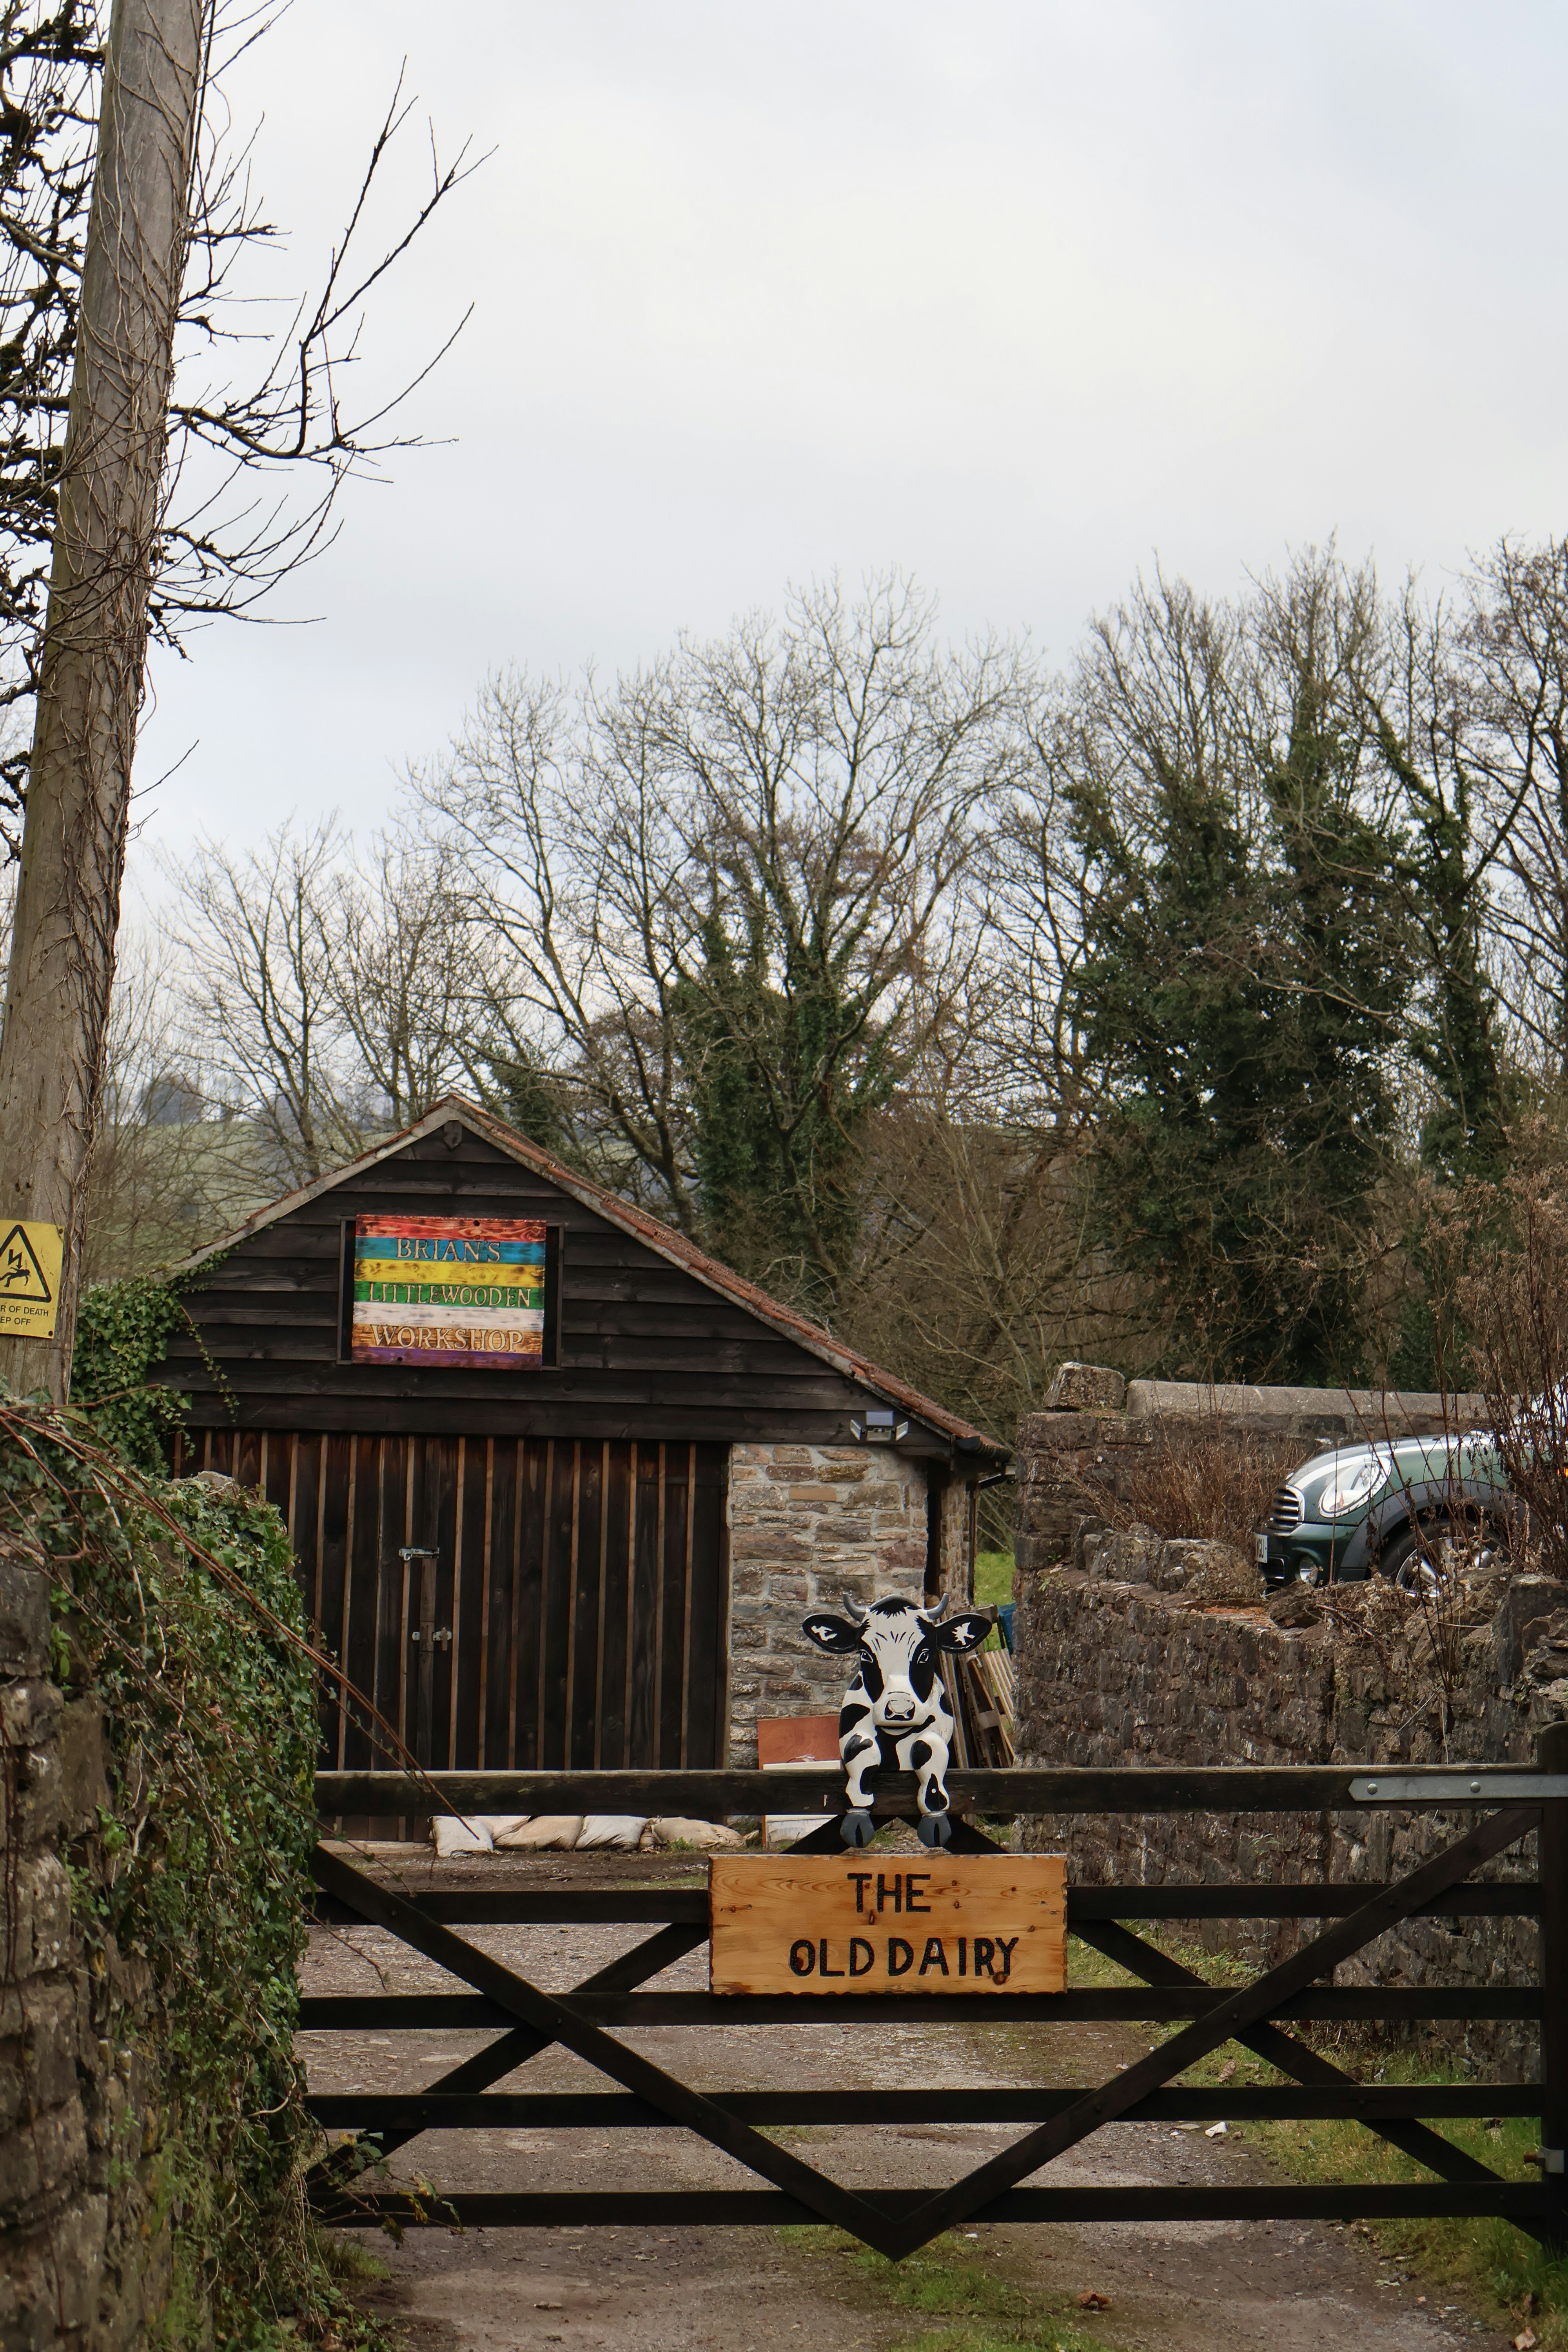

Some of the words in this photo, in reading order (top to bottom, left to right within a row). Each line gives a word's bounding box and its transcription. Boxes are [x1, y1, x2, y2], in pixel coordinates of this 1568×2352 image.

[397, 1238, 501, 1262] BRIAN'S
[24, 1307, 49, 1317] DEATH
[370, 1325, 523, 1352] WORKSHOP
[847, 1873, 931, 1913] THE
[790, 1938, 875, 1977] OLD
[888, 1937, 1019, 1977] DAIRY
